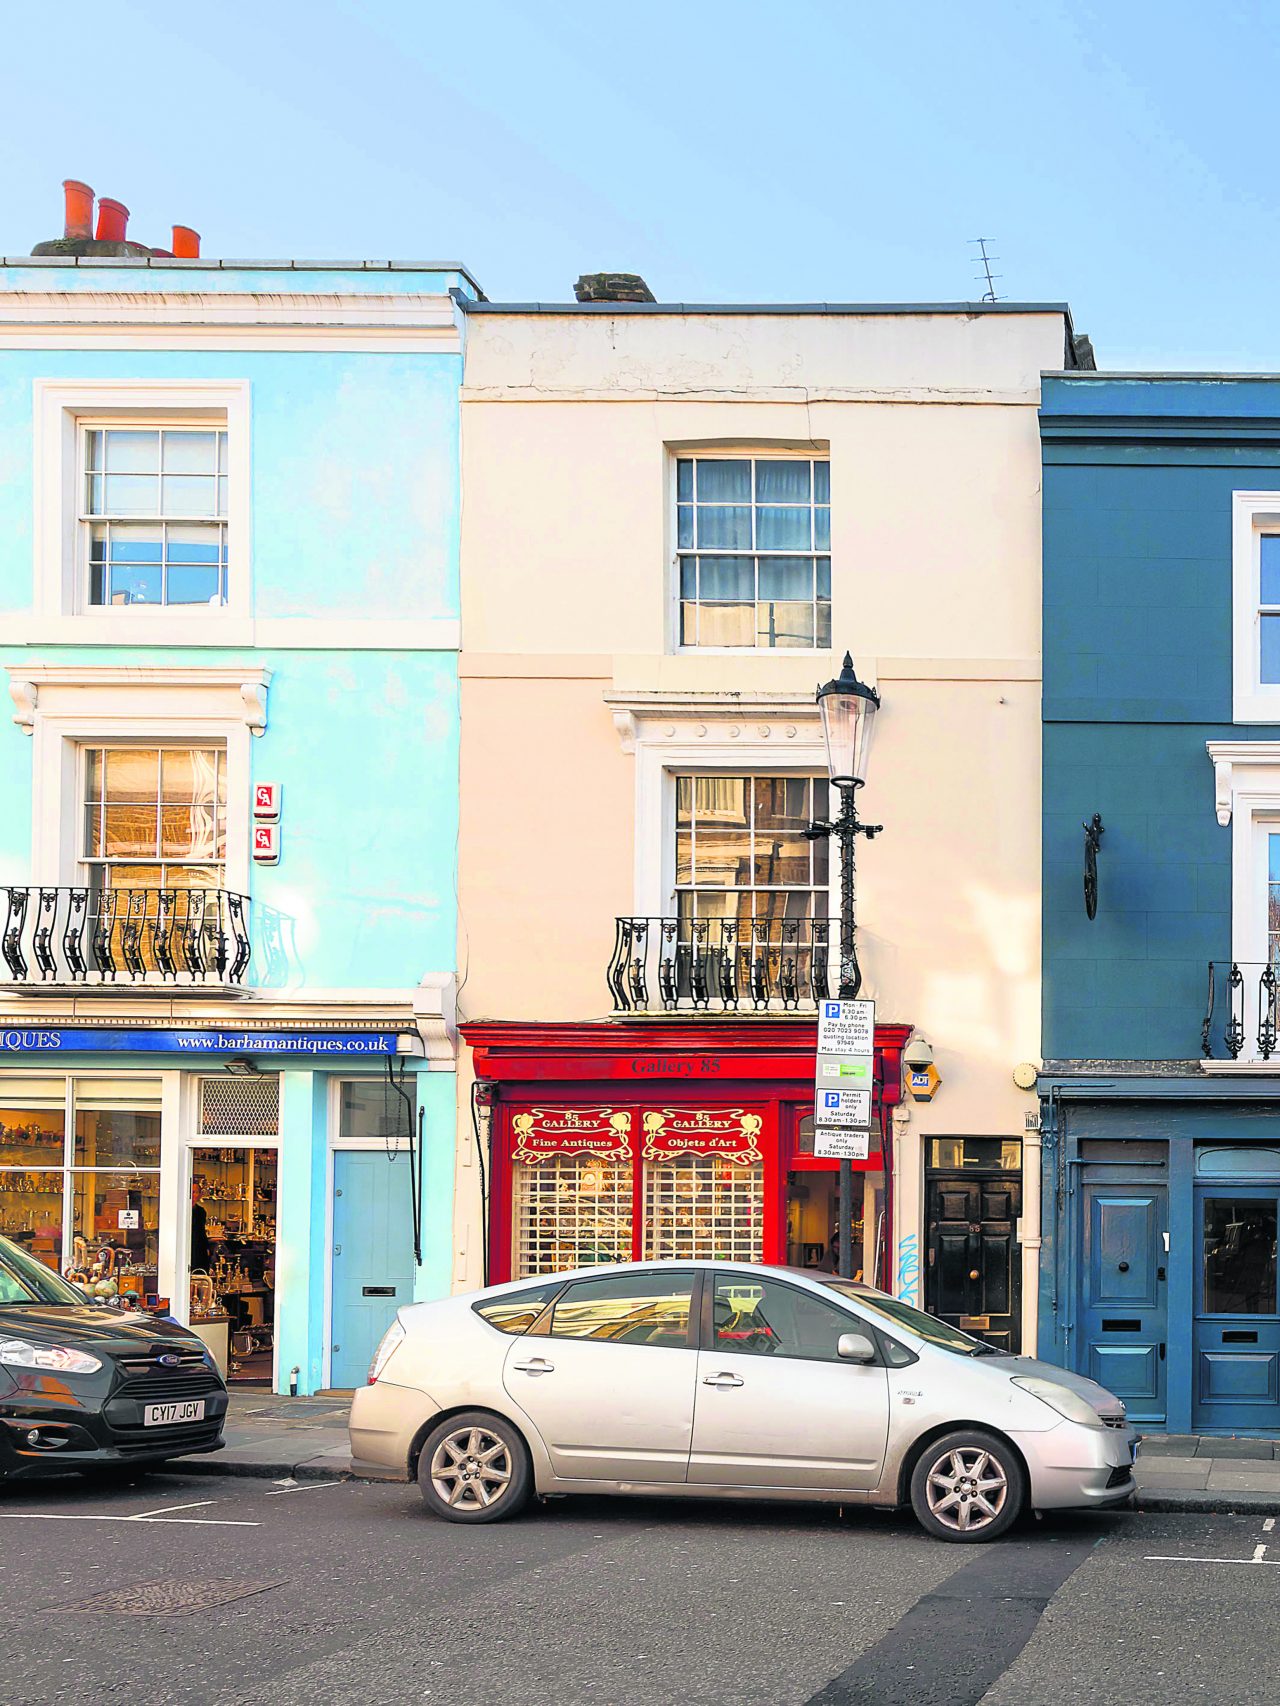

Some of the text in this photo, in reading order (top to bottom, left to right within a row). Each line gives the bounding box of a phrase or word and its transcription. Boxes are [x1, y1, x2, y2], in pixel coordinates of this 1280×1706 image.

[177, 1033, 390, 1054] www.barhamantiques.co.uk
[631, 1058, 721, 1076] Gallery 85
[912, 1075, 929, 1085] ADT
[564, 1112, 579, 1121] 85
[695, 1112, 710, 1121] 85
[542, 1119, 601, 1129] GALLERY
[672, 1119, 732, 1129] GALLERY
[532, 1139, 613, 1148] Fine Antiques
[668, 1137, 738, 1148] Objets d'Art
[152, 1403, 199, 1421] CY17 JGV
